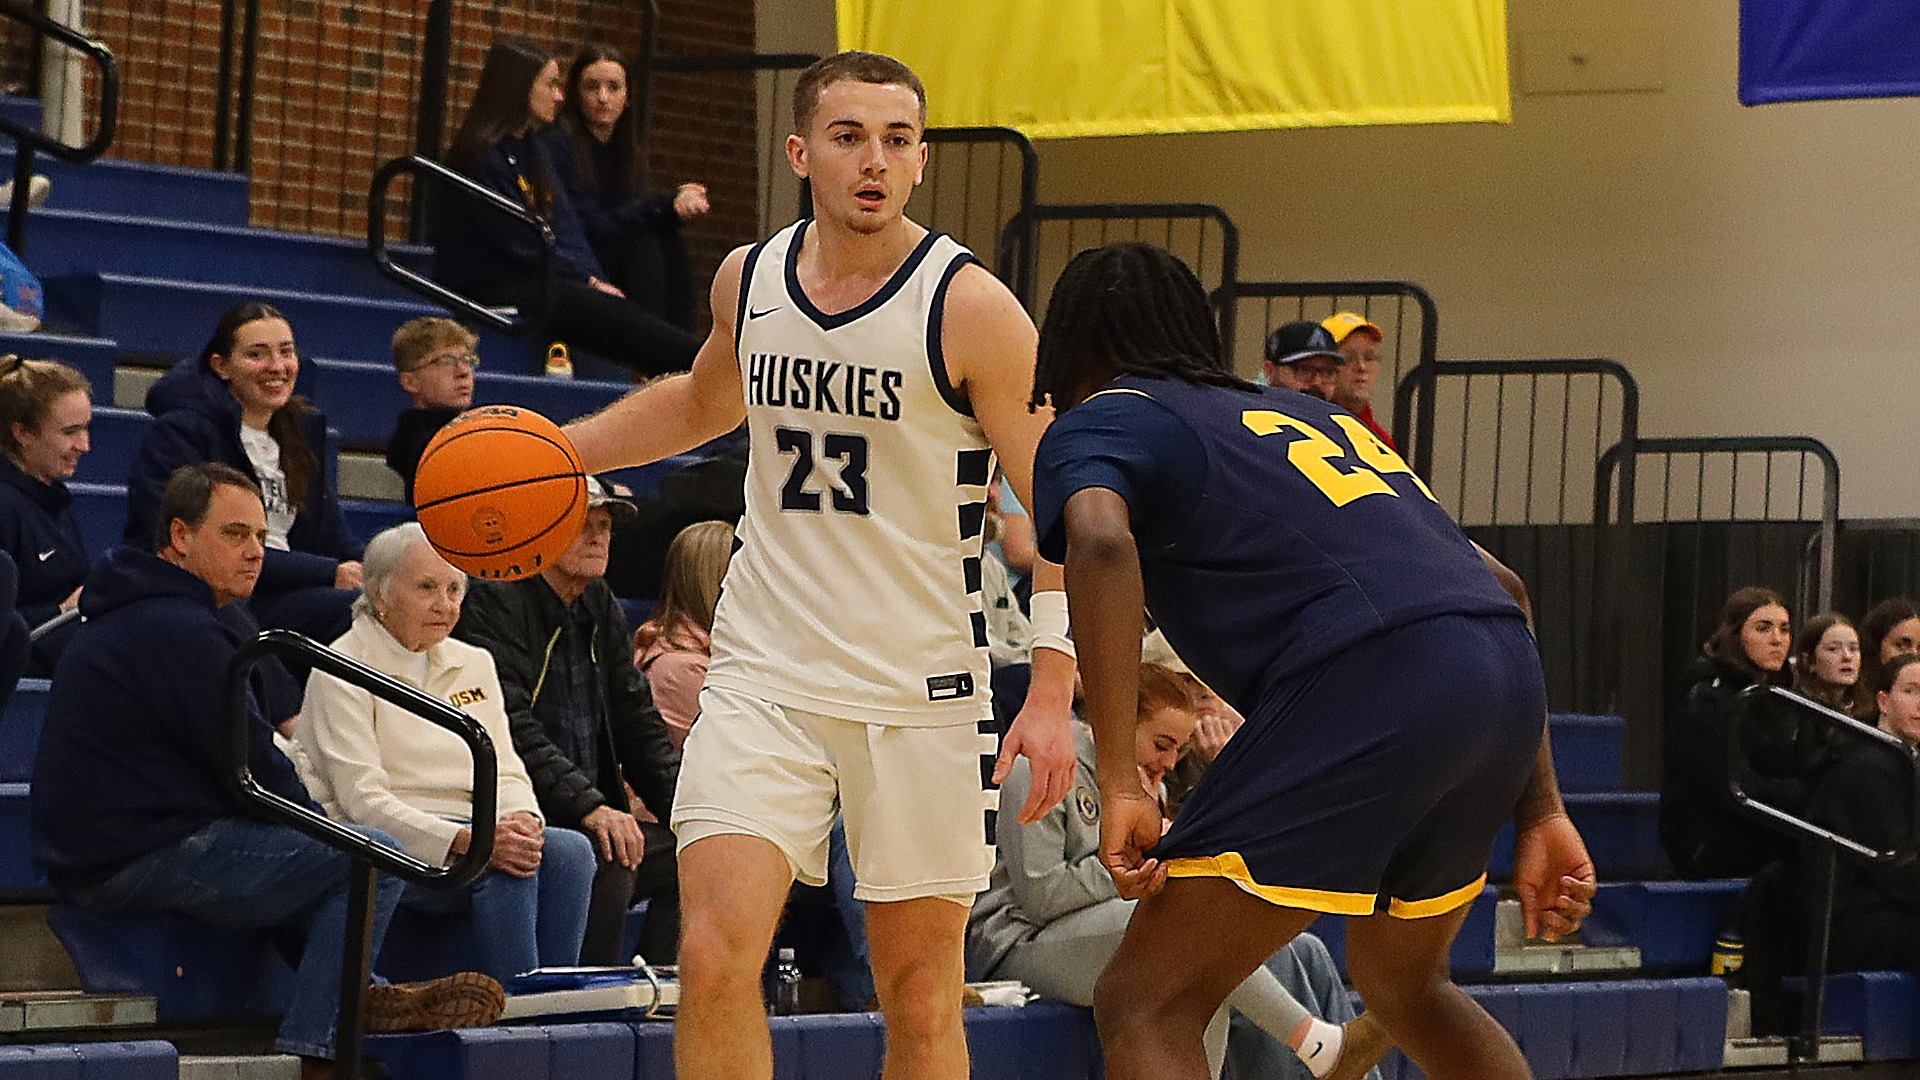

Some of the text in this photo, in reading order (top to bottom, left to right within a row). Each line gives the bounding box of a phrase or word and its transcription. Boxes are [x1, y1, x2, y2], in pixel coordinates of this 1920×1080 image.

[749, 353, 903, 422] HUSKIES
[774, 425, 872, 517] 23
[1241, 408, 1440, 508] 24
[449, 687, 488, 708] USM
[961, 680, 969, 691] L
